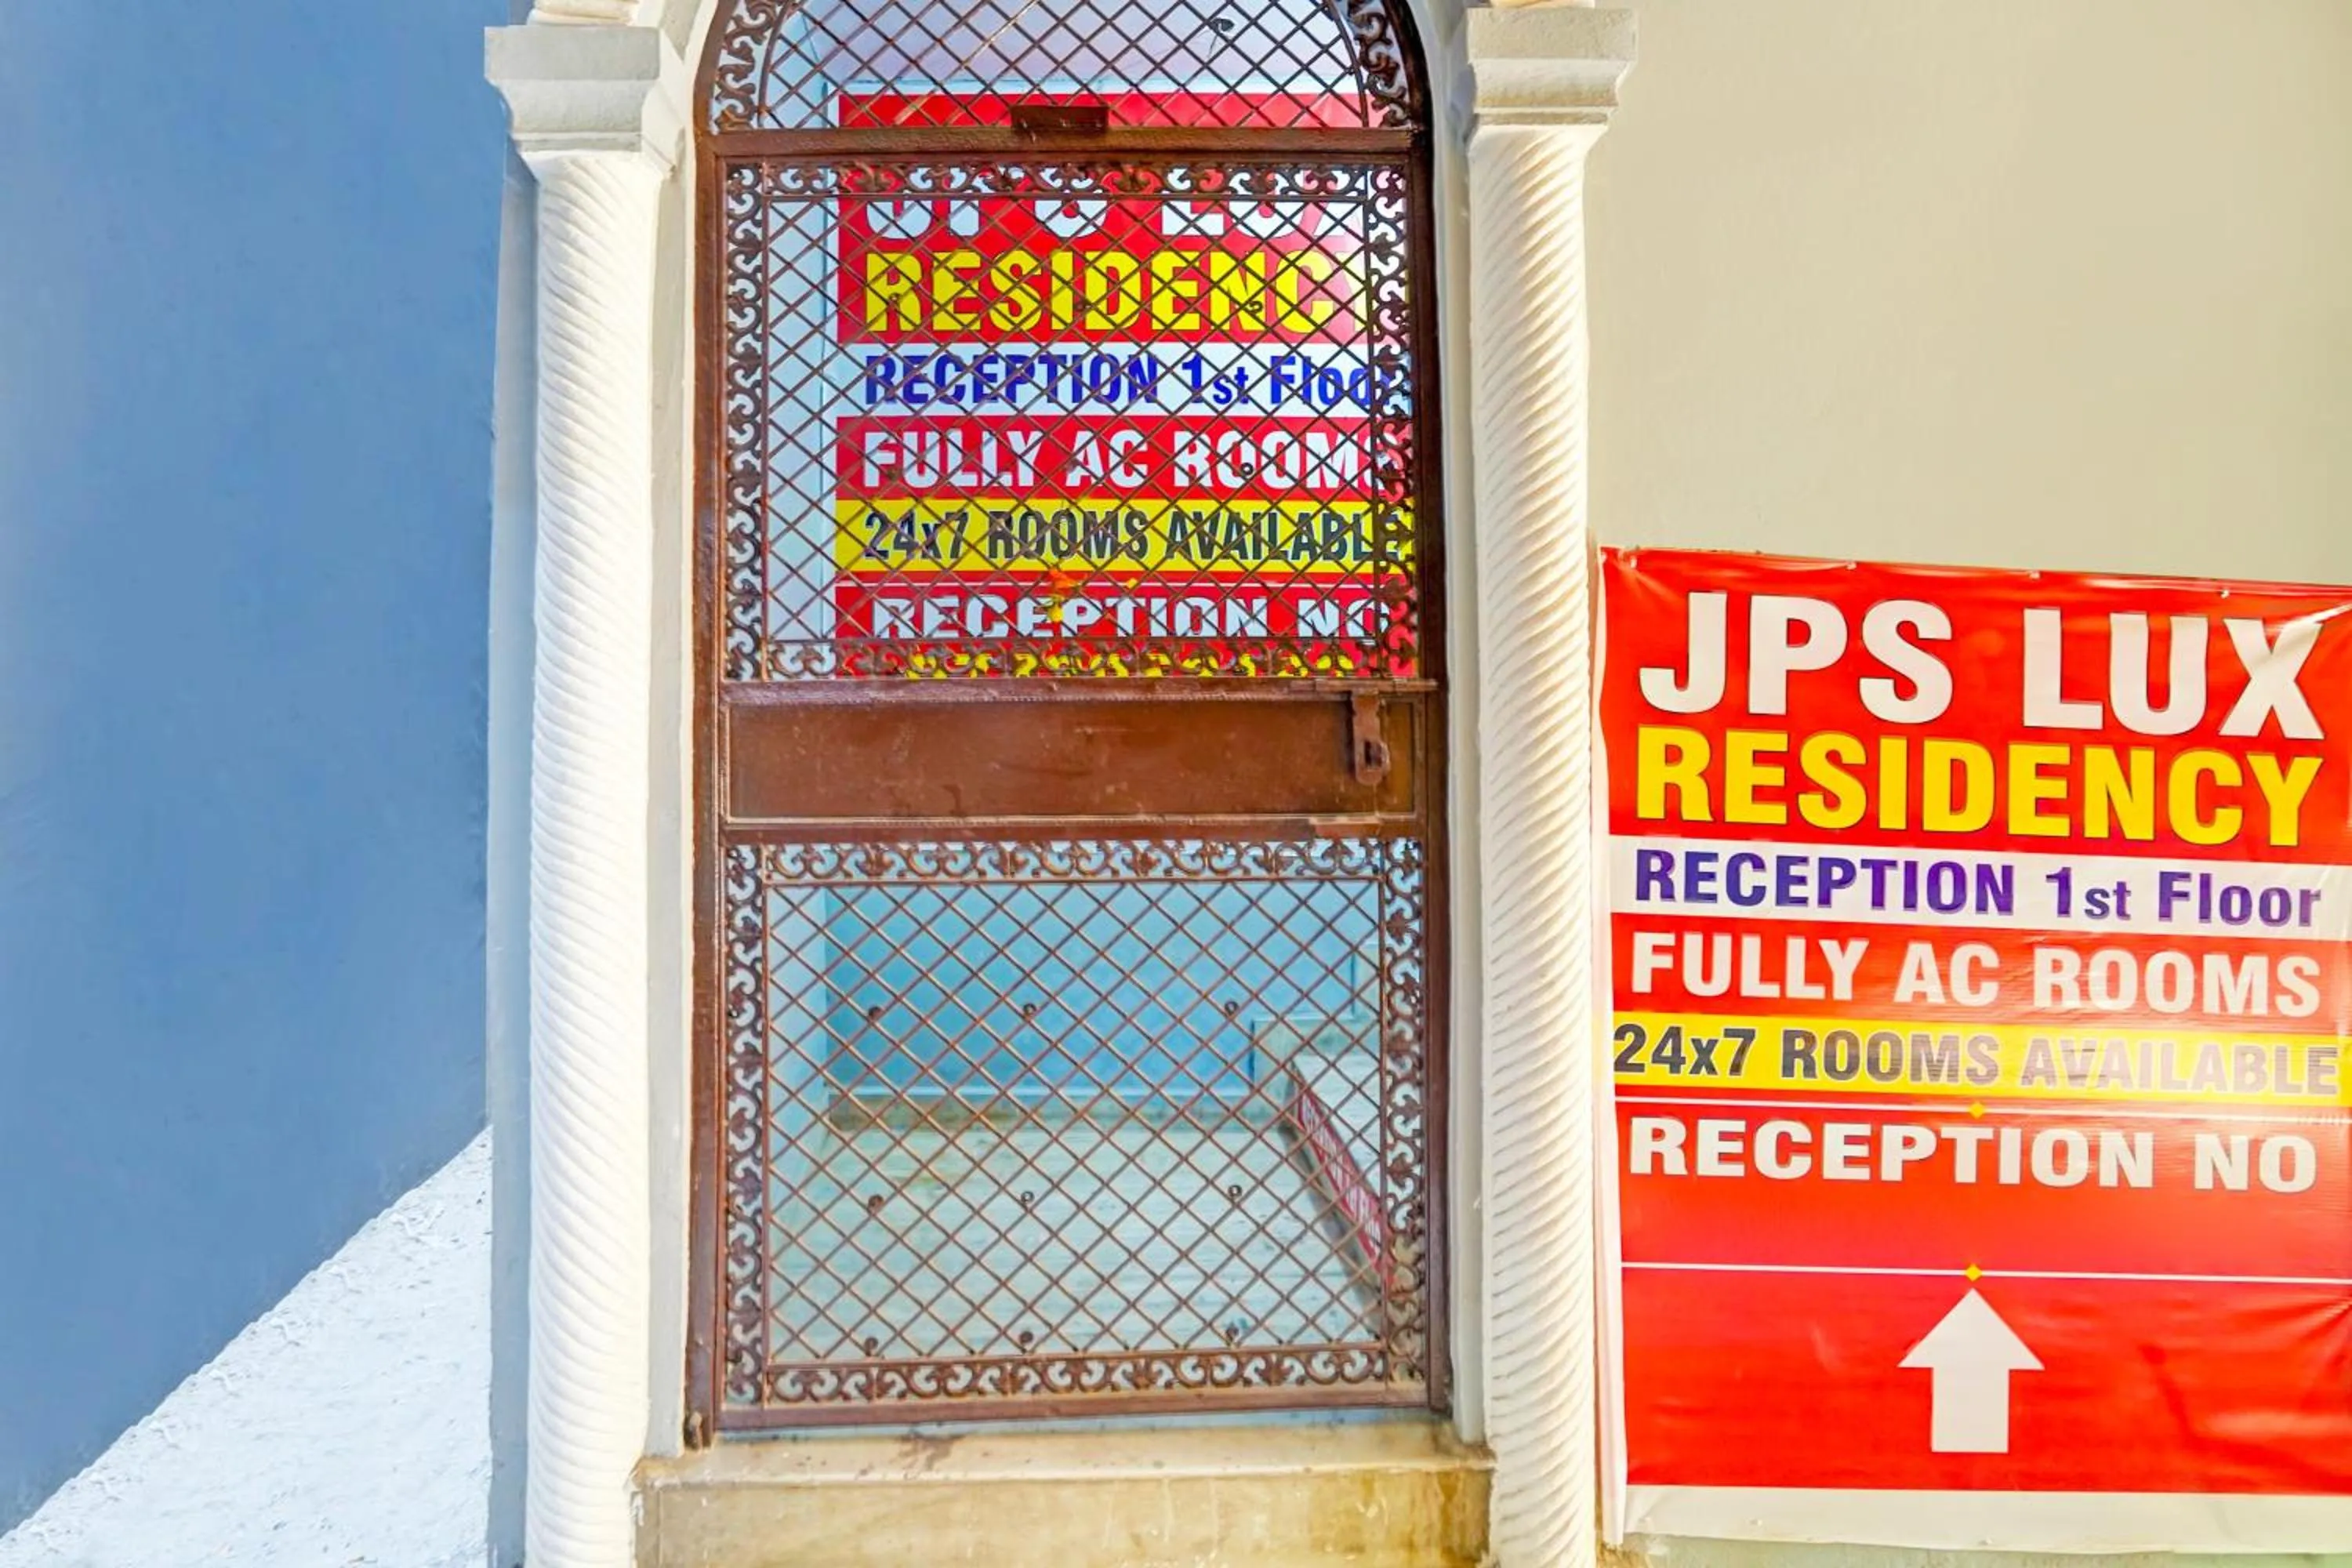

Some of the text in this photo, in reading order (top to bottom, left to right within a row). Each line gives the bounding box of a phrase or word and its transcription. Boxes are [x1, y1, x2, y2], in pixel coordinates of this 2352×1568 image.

[866, 353, 1159, 405] RECEPTION
[1181, 353, 1249, 405] 1st
[865, 429, 1042, 488] FULLY
[1065, 429, 1149, 488] AC
[865, 510, 969, 560] 24x7
[989, 510, 1149, 560] ROOMS
[873, 595, 1268, 638] RECEPTION
[1639, 591, 2325, 739] JPS LUX
[1636, 724, 2323, 847] RESIDENCY
[1635, 849, 2321, 927] RECEPTION 1st Floor
[1631, 931, 2321, 1018] FULLY AC ROOMS
[1613, 1023, 2339, 1096] 24x7 ROOMS AVAILABLE
[1629, 1116, 2318, 1194] RECEPTION NO
